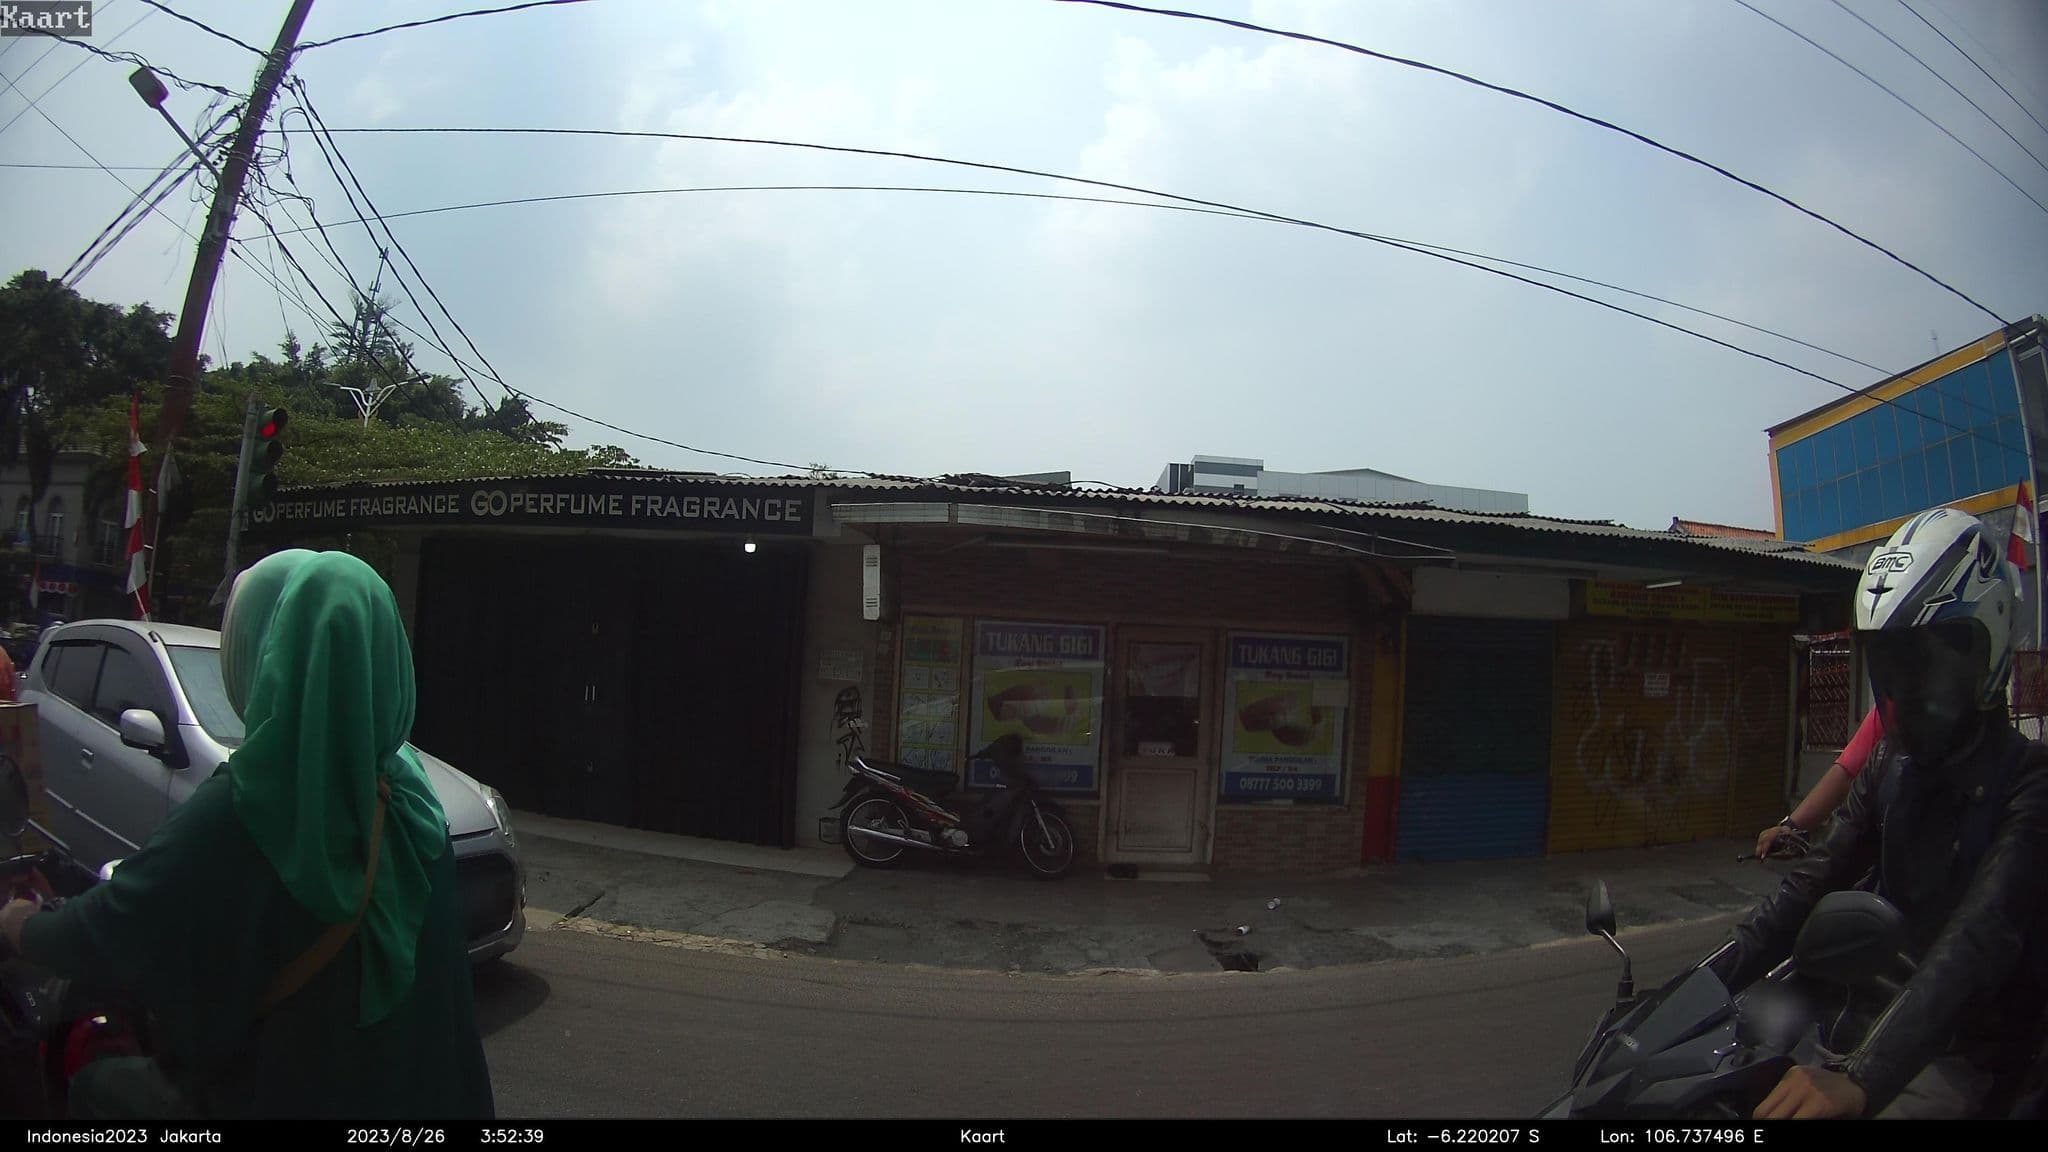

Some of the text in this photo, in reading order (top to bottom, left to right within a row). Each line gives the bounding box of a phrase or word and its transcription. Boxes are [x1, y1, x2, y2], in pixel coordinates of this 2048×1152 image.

[350, 494, 460, 516] FRAGRANCE
[631, 494, 802, 521] FRAGRANCE
[1872, 556, 1909, 570] BMC
[984, 632, 1094, 656] TUKANG GIGI
[1238, 643, 1337, 666] TUKANG GIGI
